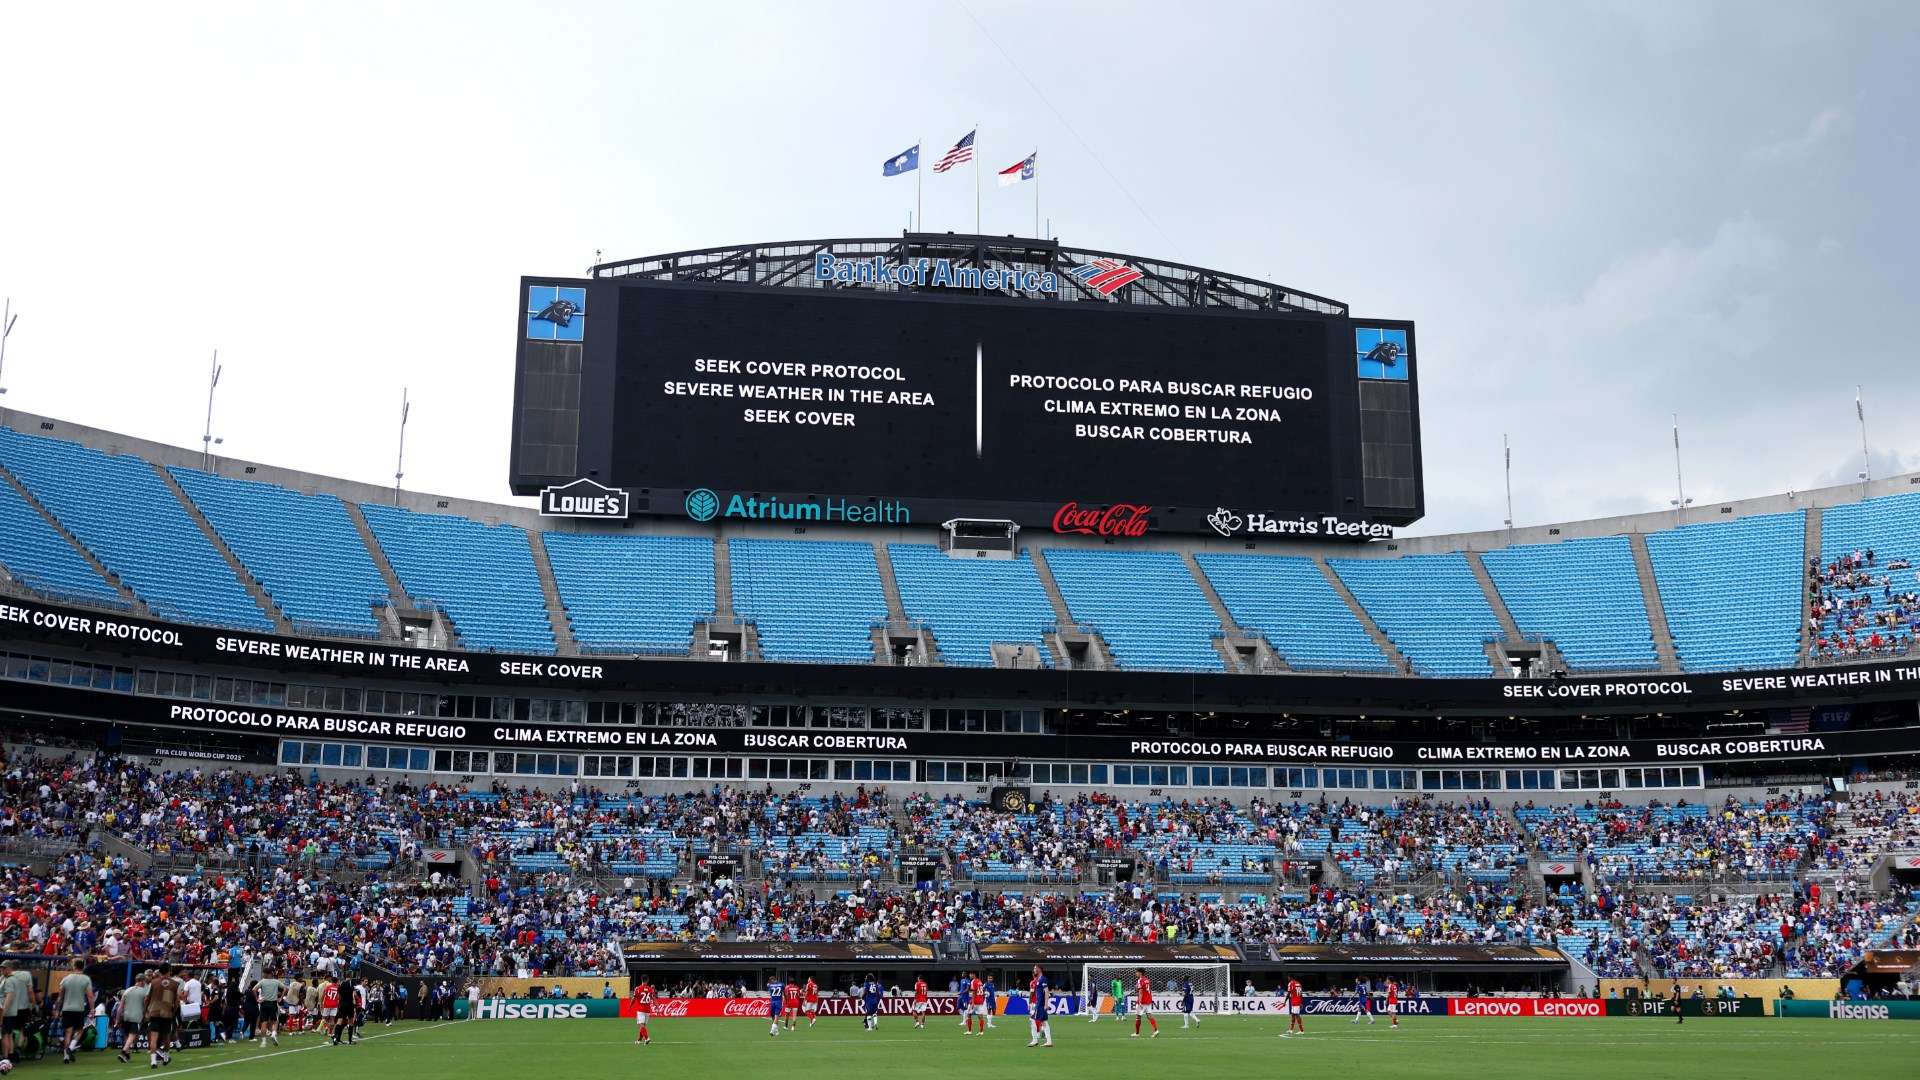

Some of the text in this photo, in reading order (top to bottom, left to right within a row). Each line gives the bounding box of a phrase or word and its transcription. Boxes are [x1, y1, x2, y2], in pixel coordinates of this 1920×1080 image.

[815, 253, 1058, 293] Bank of America
[694, 358, 906, 381] SEEK COVER PROTOCOL
[664, 381, 935, 406] SEVERE WEATHER IN THE AREA
[1010, 374, 1313, 401] PROTOCOLO PARA BUSCAR REFUGIO
[743, 408, 856, 427] SEEK COVER
[1044, 399, 1282, 422] CLIMA EXTREMO EN LA ZONA
[1075, 424, 1253, 444] BUSCAR COBERTURA
[549, 492, 620, 515] LOWE'S
[725, 494, 910, 524] Atrium Health
[1052, 502, 1152, 537] Coca-Cola
[1247, 513, 1393, 539] Harris Teeter
[0, 604, 183, 646] EEK COVER PROTOCOL
[215, 637, 470, 673] SEVERE WEATHER IN THE AREA
[500, 661, 603, 679] SEEK COVER
[1722, 666, 1920, 692] SEVERE WEATHER IN TH
[1503, 685, 1544, 698] SEEK
[1605, 681, 1693, 696] PROTOCOL
[170, 705, 466, 739] PROTOCOLO PARA BUSCAR REFUGIO
[493, 727, 718, 746] CLIMA EXTREMO EN LA ZONA
[744, 734, 908, 749] BUSCAR COBERTURA
[188, 751, 211, 759] WORLD
[1131, 741, 1394, 759] PROTOCOLO PARA BUSCAR REFUGIO
[1417, 745, 1631, 759] CLIMA EXTREMO EN LA ZONA
[1656, 738, 1825, 756] BUSCAR COBERTURA
[327, 991, 338, 1000] 47
[640, 992, 651, 1004] 26
[771, 987, 782, 997] 22
[790, 991, 798, 1000] 17
[477, 999, 588, 1019] Hisense
[723, 999, 771, 1016] Coca-Cola
[818, 999, 867, 1015] ATAR
[1131, 1001, 1169, 1011] BNK
[1376, 1000, 1430, 1013] UTRA
[1454, 999, 1521, 1015] Lenovo
[1533, 999, 1600, 1016] Lenovo
[1643, 1002, 1665, 1014] PIF
[1718, 1001, 1741, 1013] PIF
[1829, 999, 1889, 1019] Hisense
